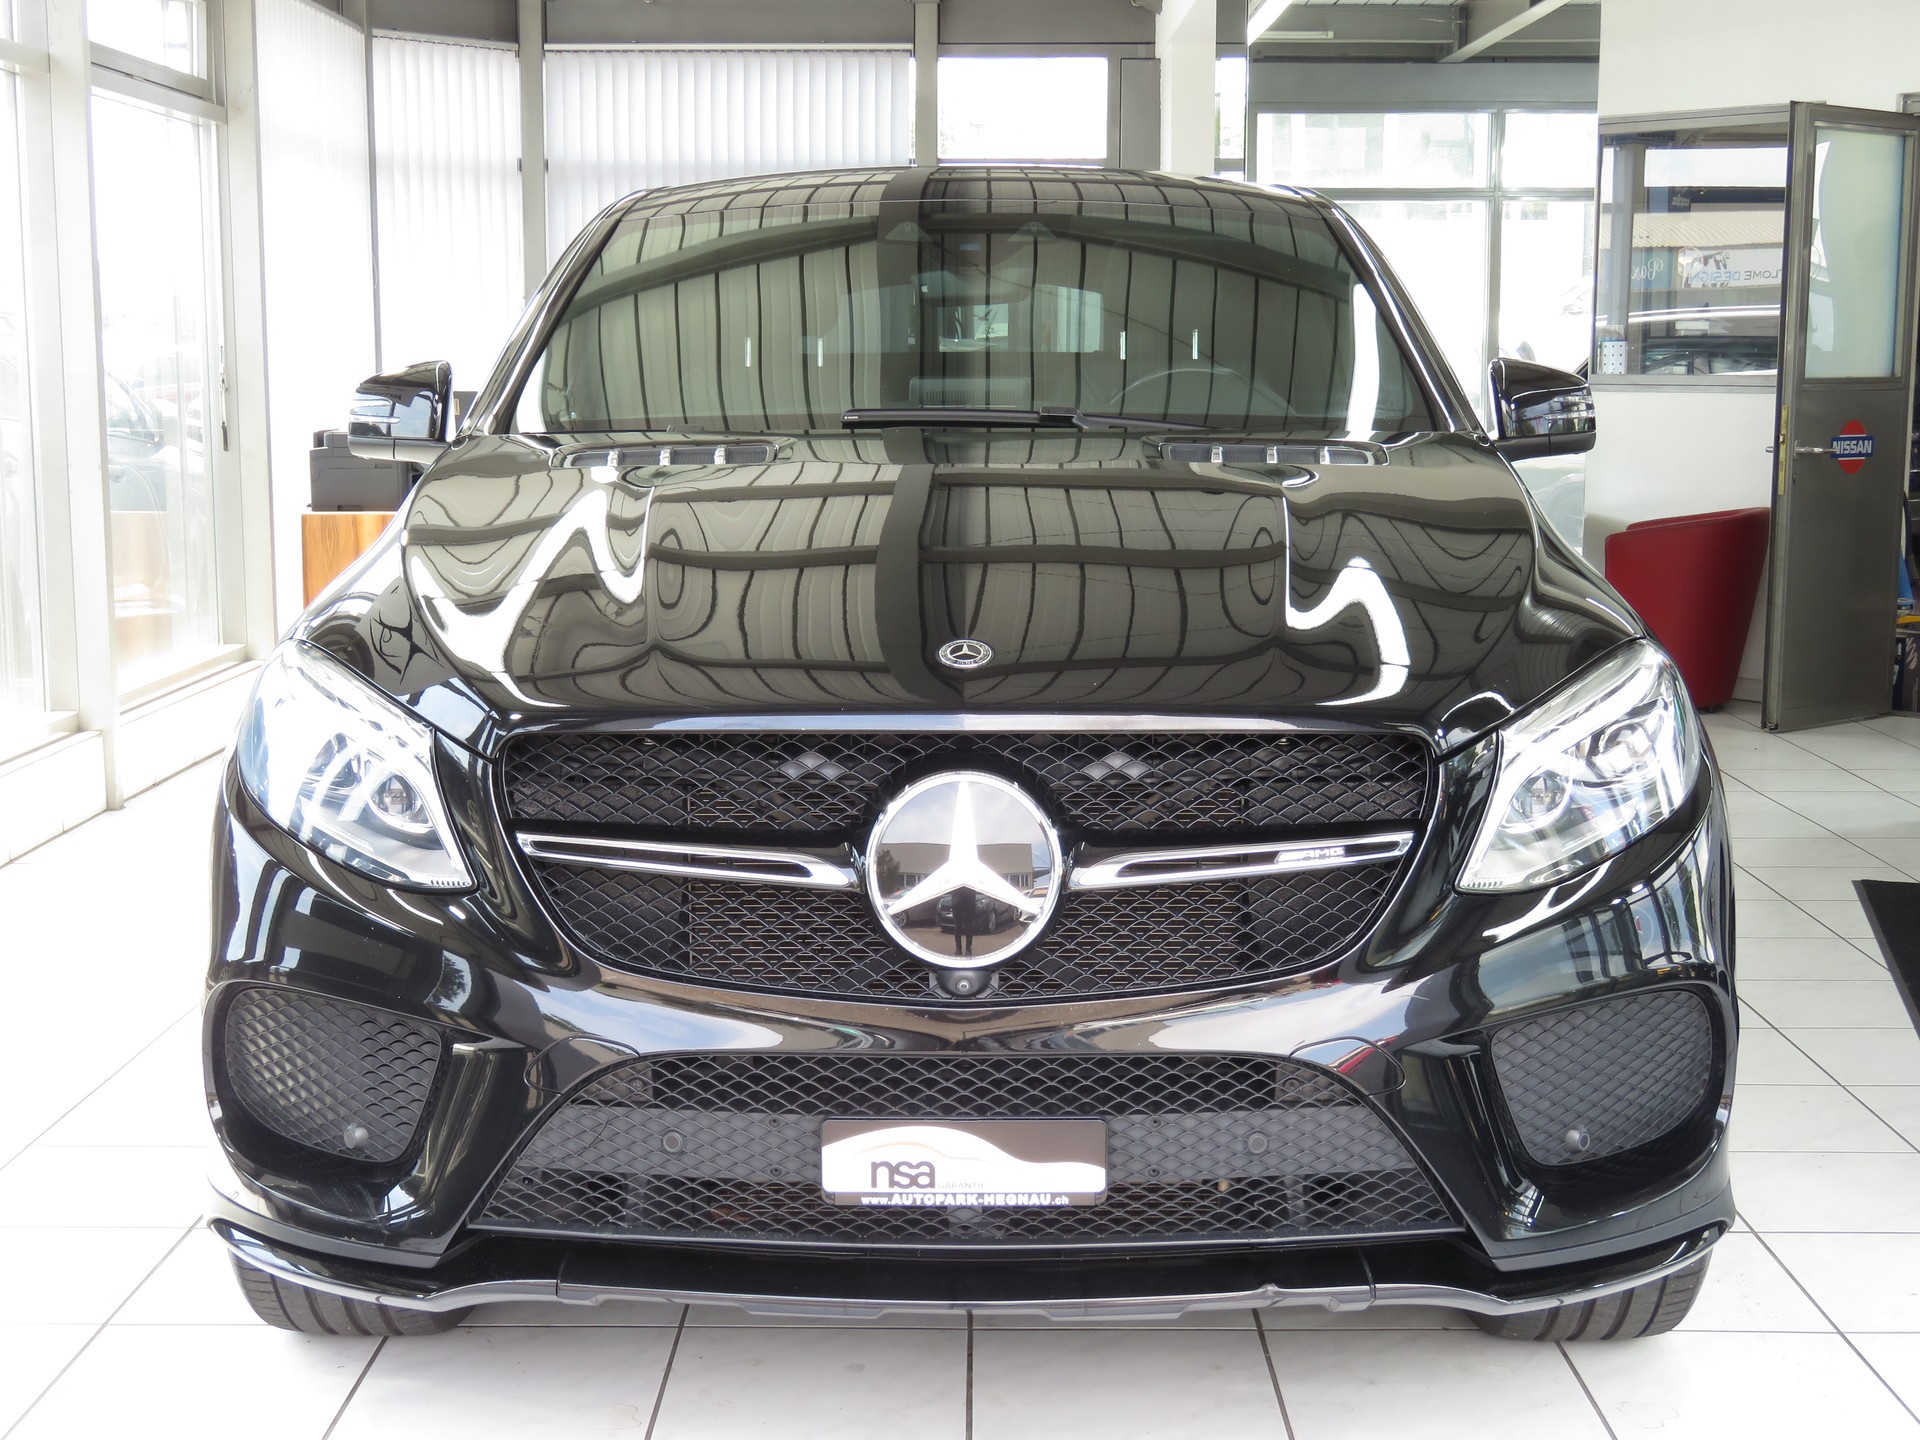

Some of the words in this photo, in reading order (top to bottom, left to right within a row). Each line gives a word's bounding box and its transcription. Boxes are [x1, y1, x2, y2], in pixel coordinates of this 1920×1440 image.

[1832, 440, 1872, 454] NISSAN
[1303, 847, 1344, 858] AMG
[870, 1160, 935, 1189] nsa
[860, 1192, 1069, 1206] www.AUTOPARK-HEGNAU.ch
